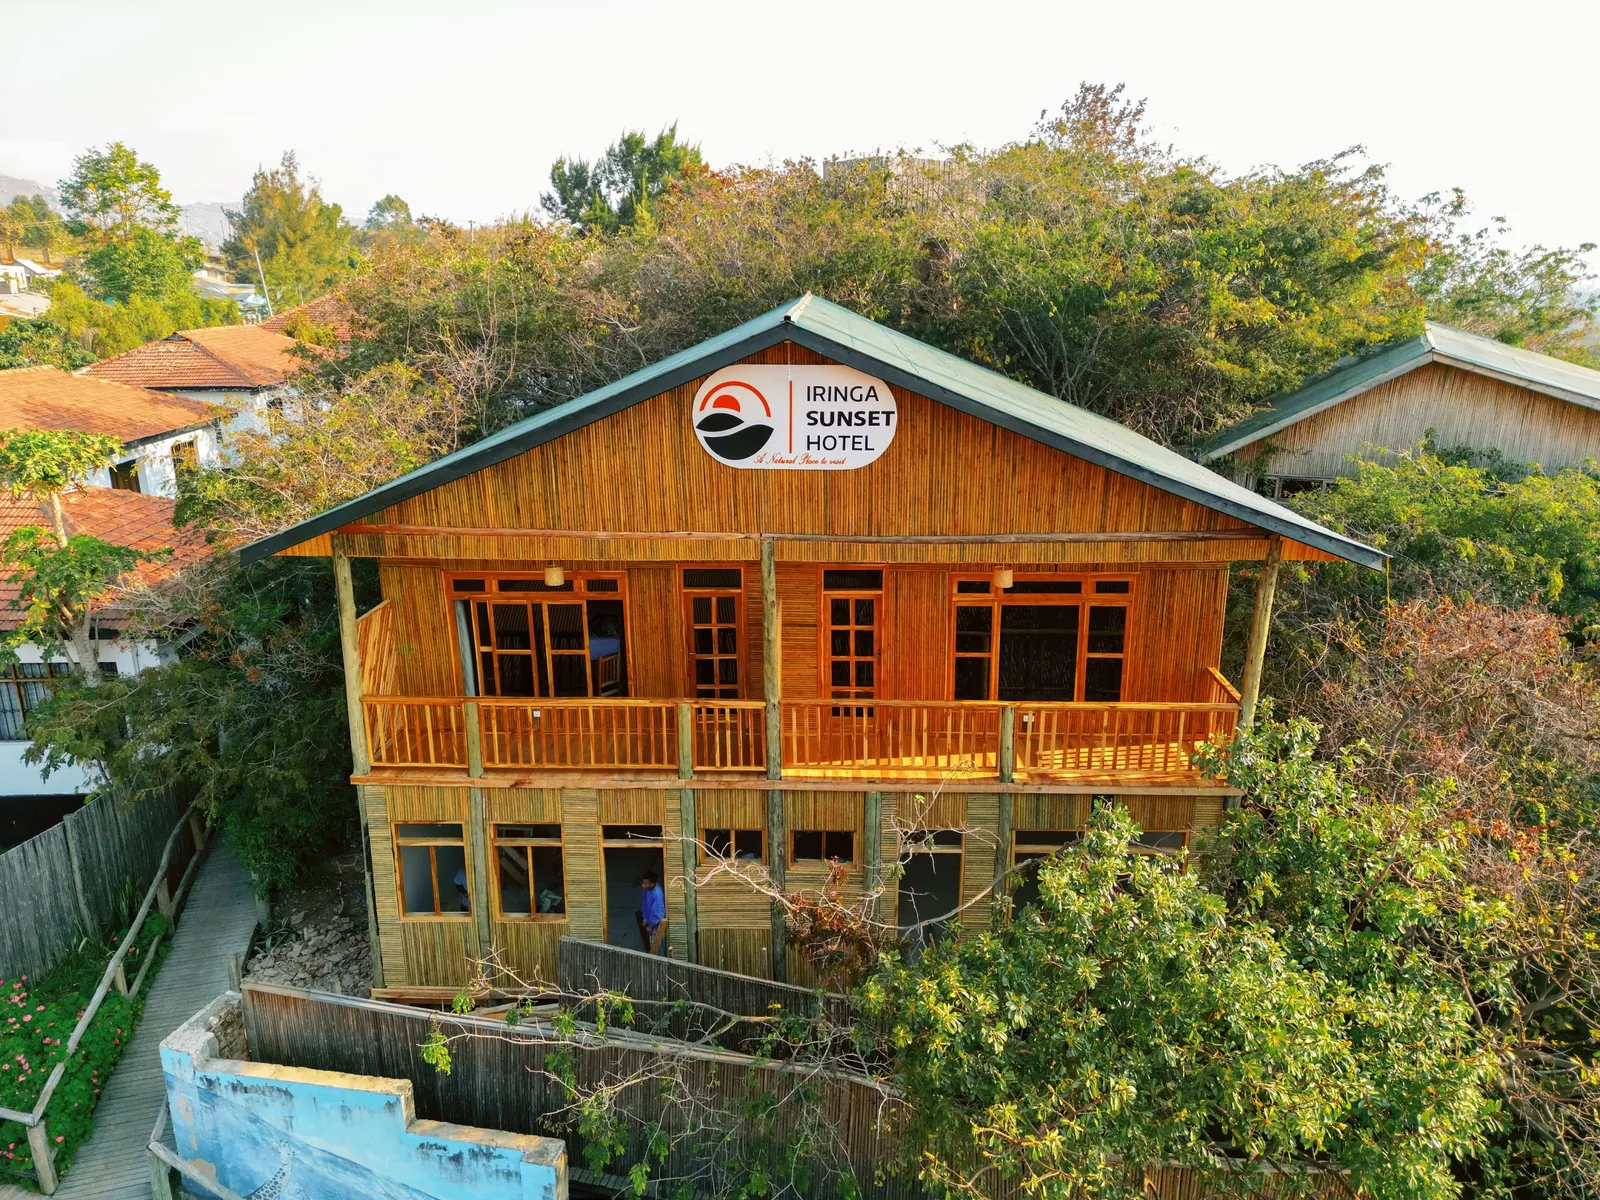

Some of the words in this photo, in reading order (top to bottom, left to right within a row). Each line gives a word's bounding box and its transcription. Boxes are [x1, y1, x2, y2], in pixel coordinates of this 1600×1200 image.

[806, 385, 879, 402] IRINGA
[806, 410, 896, 427] SUNSET
[806, 434, 875, 451] HOTEL
[754, 452, 767, 464] A
[766, 452, 798, 465] Natural
[798, 453, 819, 465] Place
[820, 457, 828, 465] to
